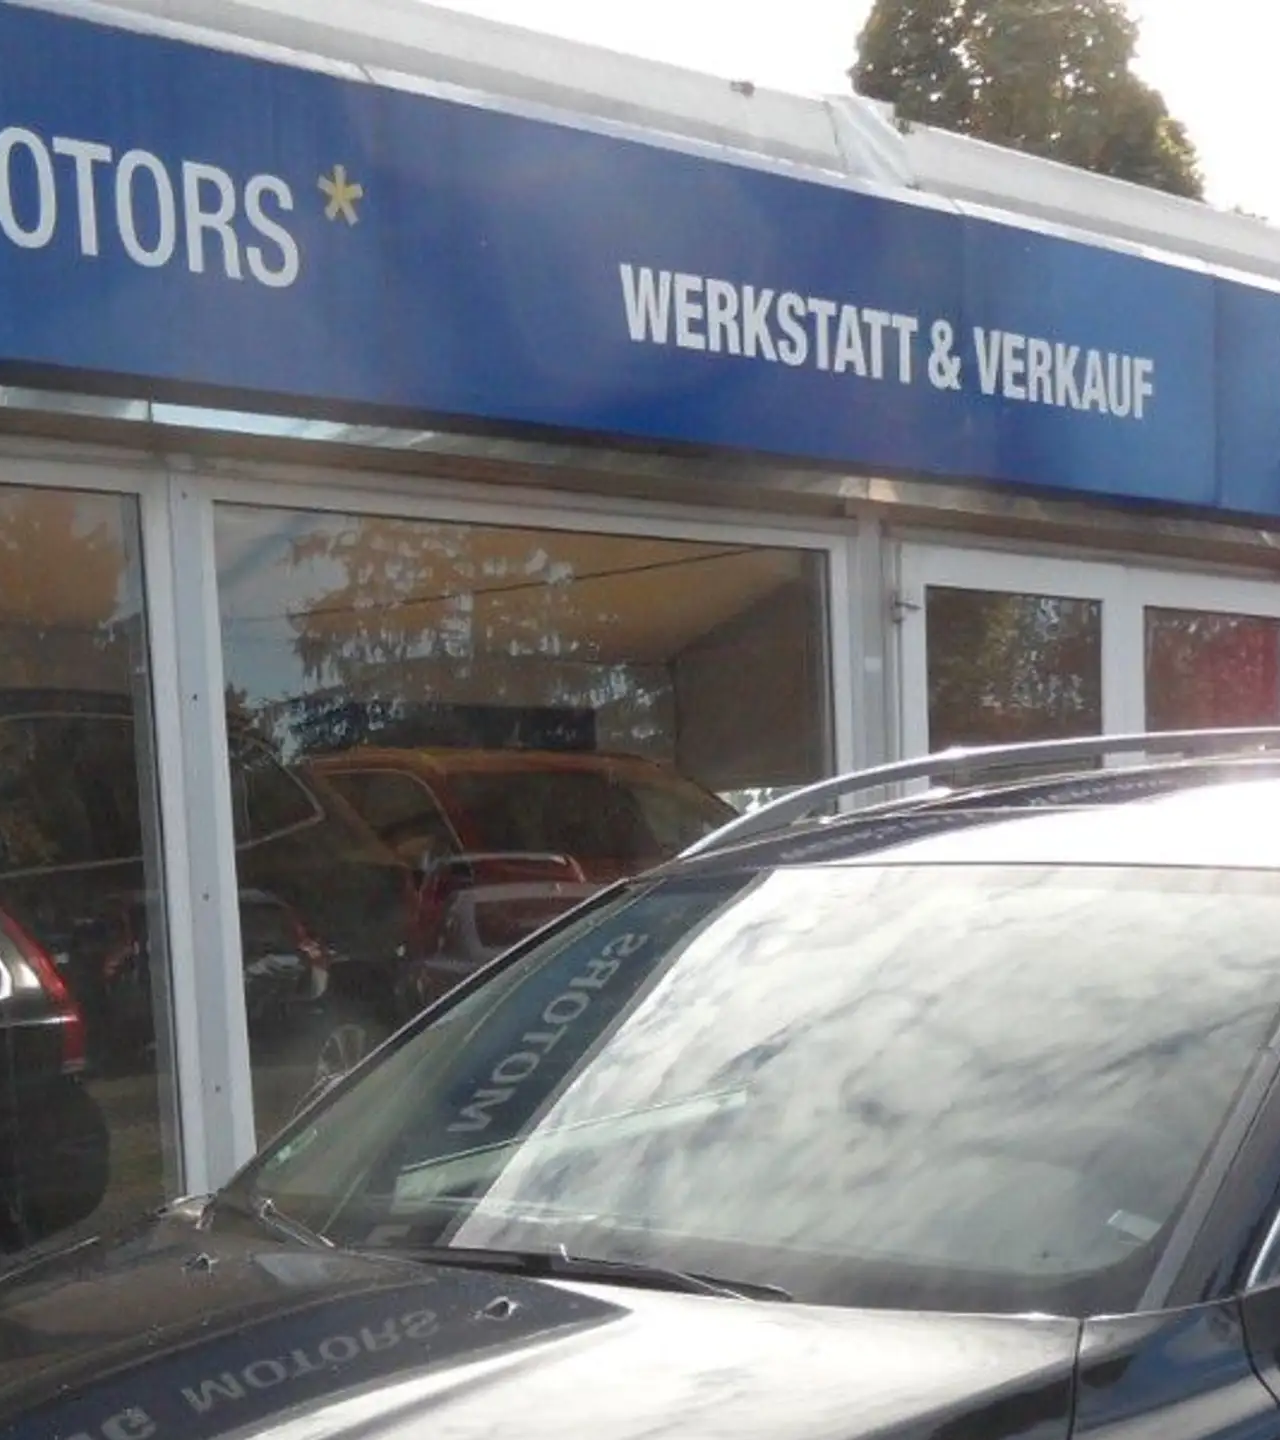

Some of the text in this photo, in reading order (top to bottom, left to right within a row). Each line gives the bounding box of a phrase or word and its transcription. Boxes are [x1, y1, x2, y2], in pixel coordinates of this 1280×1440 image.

[620, 263, 1155, 420] WERKSTATT & VERKAUF
